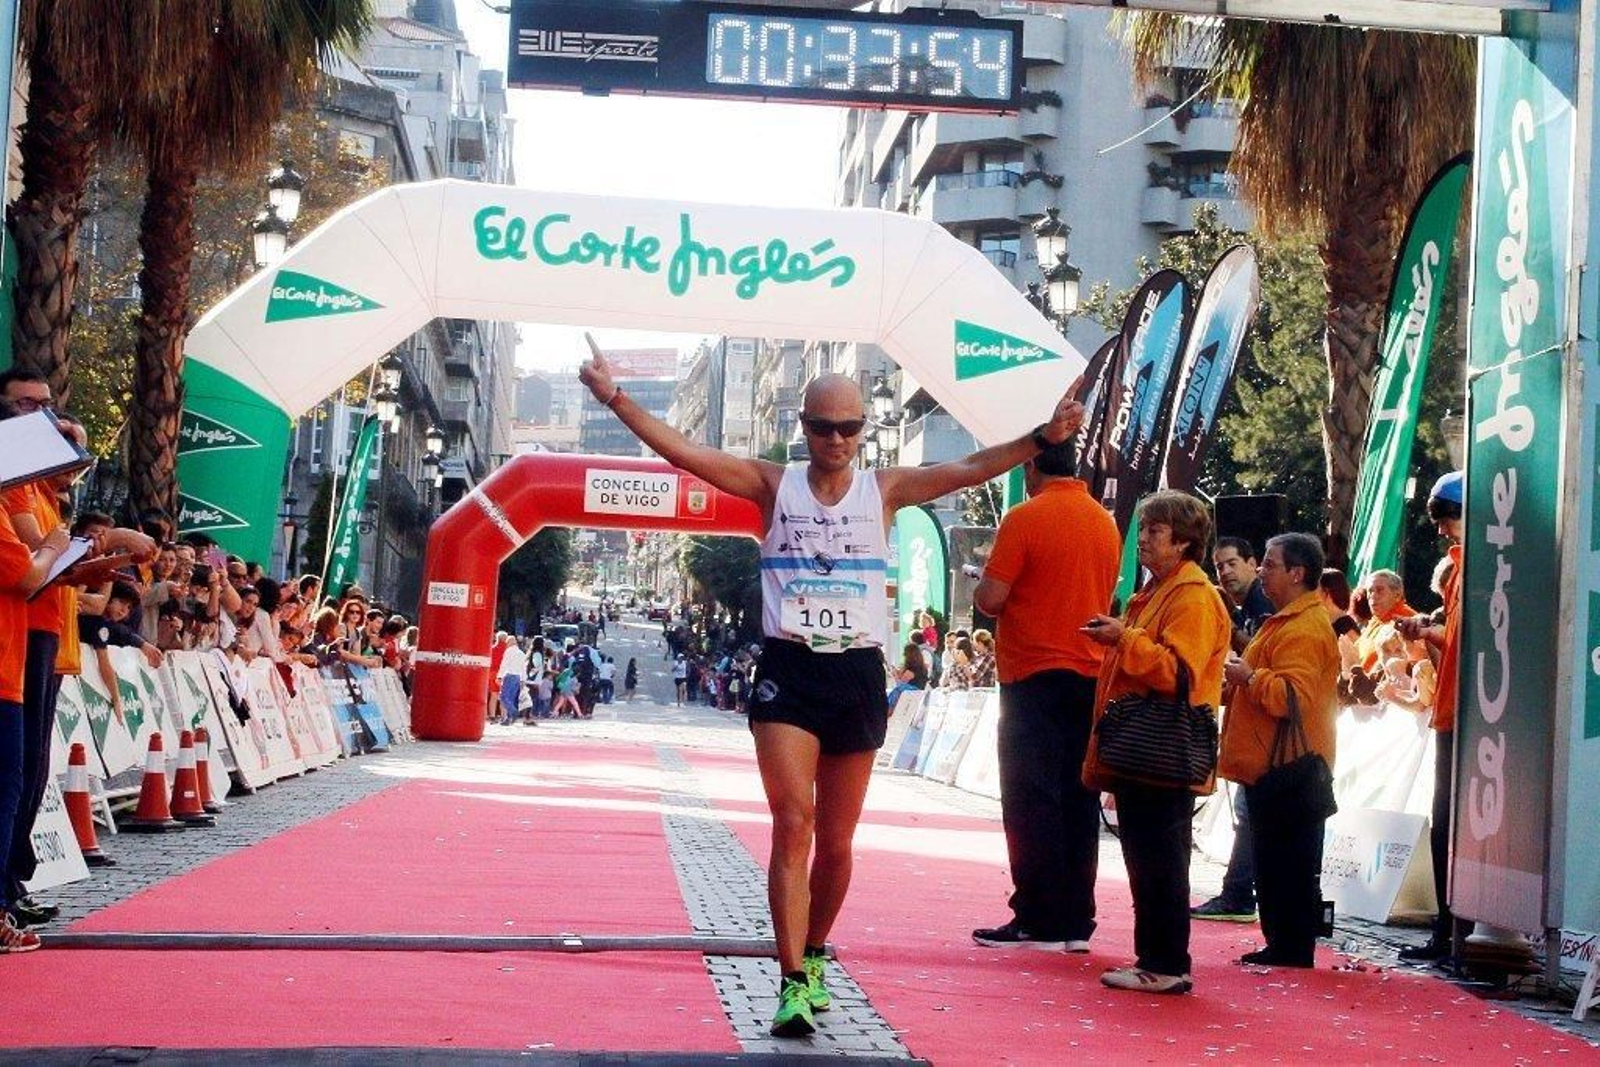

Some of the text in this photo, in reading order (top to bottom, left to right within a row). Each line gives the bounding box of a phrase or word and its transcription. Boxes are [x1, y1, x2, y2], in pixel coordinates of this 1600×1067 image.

[712, 18, 1010, 98] 00:33:54
[473, 205, 857, 300] El Corte Inglés
[273, 284, 363, 309] El Corte Inglés
[956, 339, 1044, 362] El Corte Inglés
[191, 422, 236, 444] Inglés
[1468, 98, 1539, 843] El Corte Inglés
[591, 478, 670, 493] CONCELLO
[600, 493, 660, 507] DE VIGO
[179, 502, 223, 524] Inglés
[799, 608, 852, 630] 101
